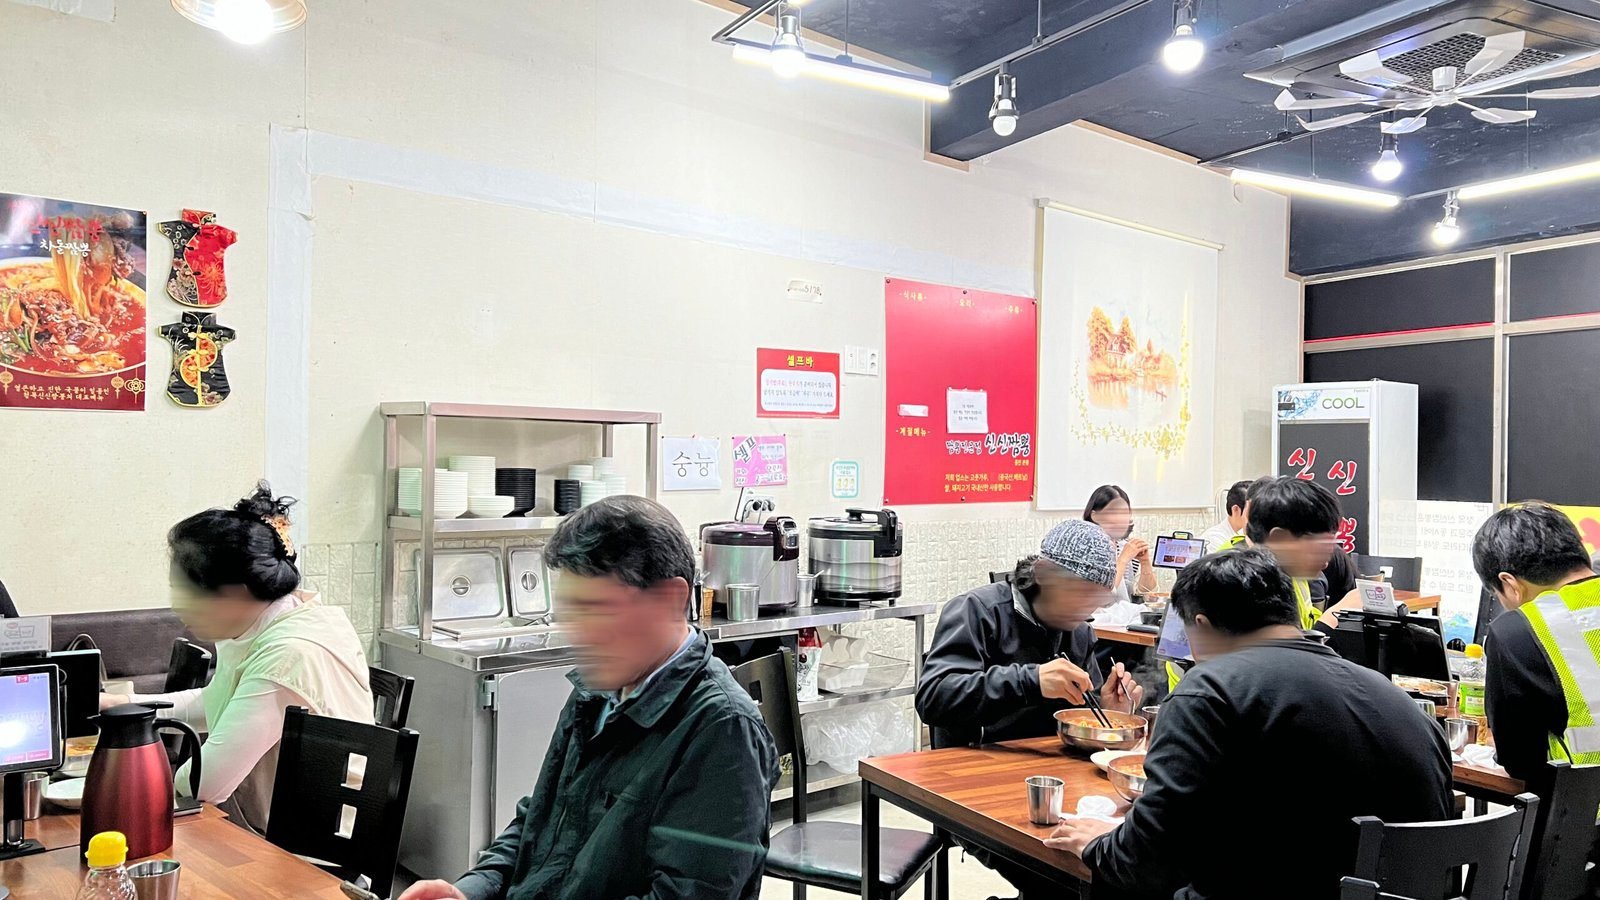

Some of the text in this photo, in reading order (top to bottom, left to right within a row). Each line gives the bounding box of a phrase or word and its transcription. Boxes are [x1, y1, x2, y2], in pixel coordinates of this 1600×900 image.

[40, 238, 91, 257] 차돌짬뽕
[787, 354, 814, 367] 셀프바
[48, 385, 61, 393] 진한
[65, 386, 86, 394] 국물이
[1322, 397, 1365, 410] COOL
[734, 437, 756, 463] 셀프
[984, 432, 1030, 457] 신신짬뽕
[672, 450, 714, 477] 숭늉
